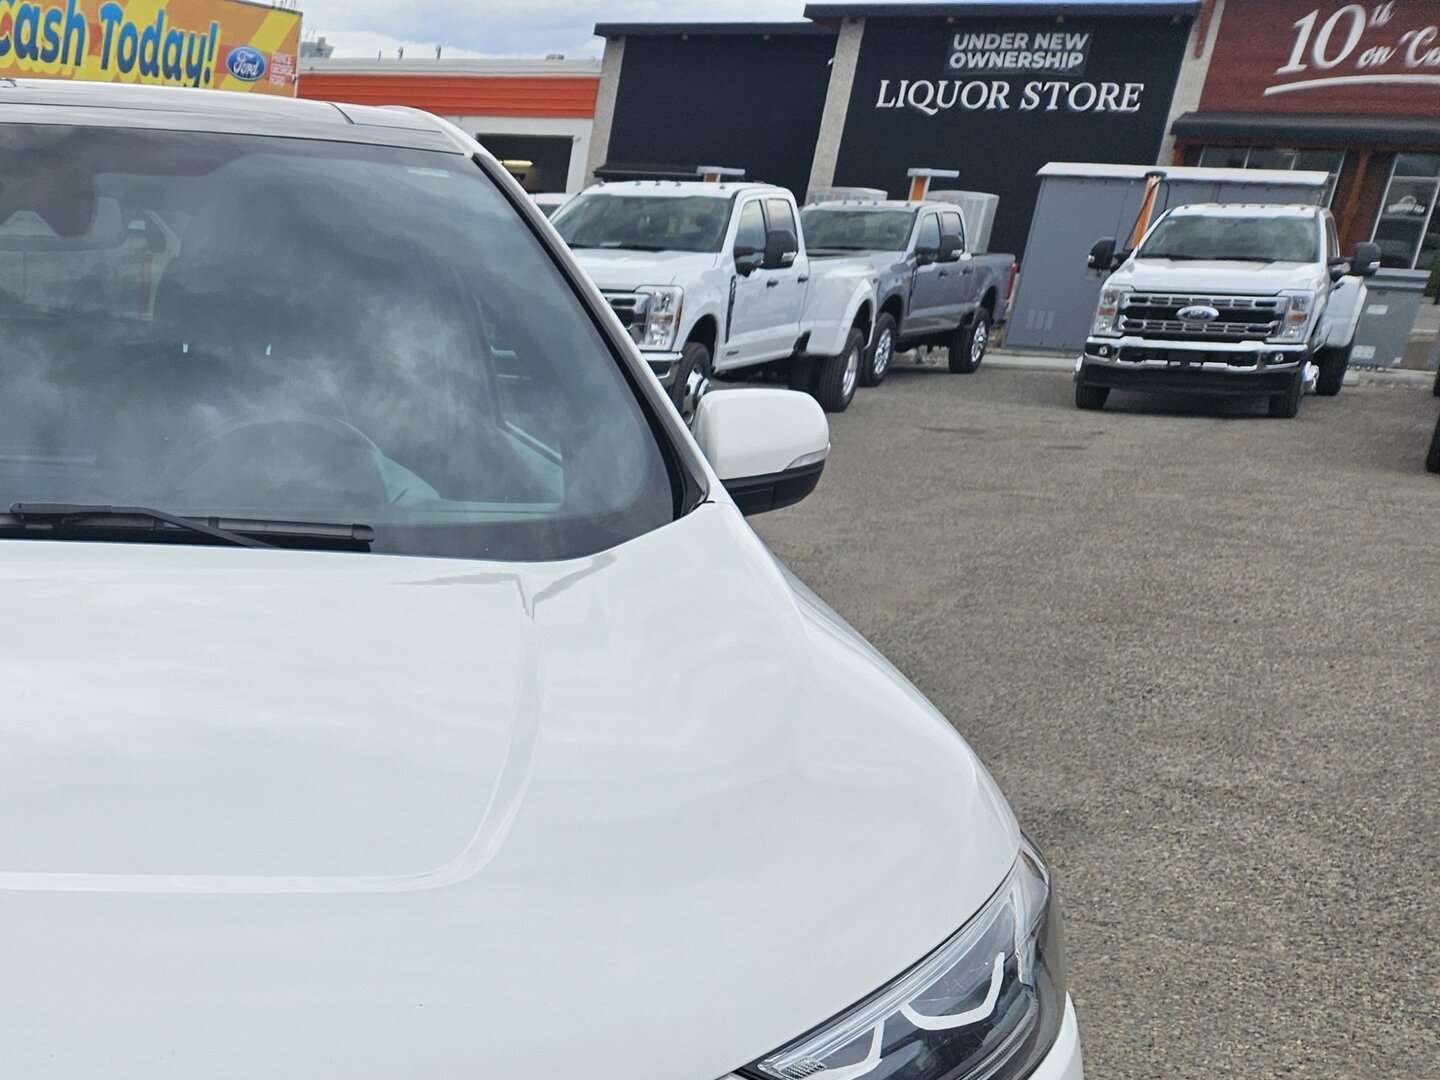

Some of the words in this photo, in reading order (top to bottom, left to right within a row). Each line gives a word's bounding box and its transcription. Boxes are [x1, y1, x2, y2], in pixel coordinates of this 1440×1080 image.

[100, 3, 219, 88] Today!
[953, 33, 1029, 51] UNDER
[1033, 33, 1089, 51] NEW
[232, 50, 261, 78] Ford
[949, 51, 1084, 70] OWNERSHIP
[1357, 45, 1398, 69] on
[875, 79, 1011, 116] LIQUOR
[1019, 81, 1145, 113] STORE
